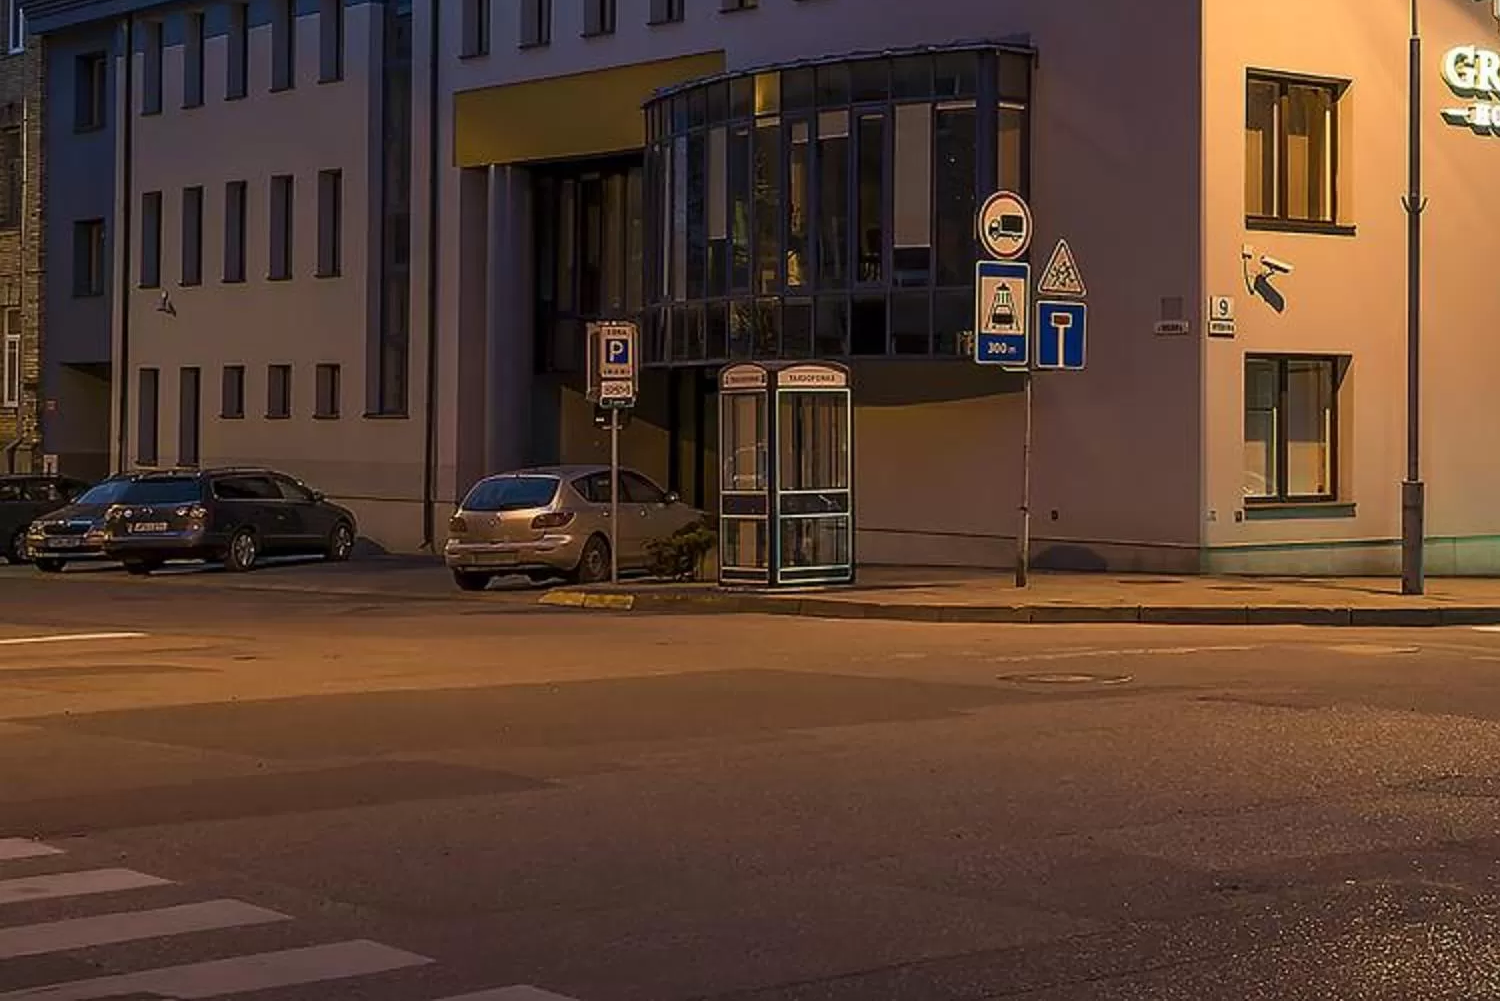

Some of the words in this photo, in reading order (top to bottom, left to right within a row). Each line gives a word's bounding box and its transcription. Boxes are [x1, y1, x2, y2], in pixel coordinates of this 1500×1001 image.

[1219, 299, 1229, 316] 9
[609, 340, 624, 362] P
[987, 342, 1007, 354] 300
